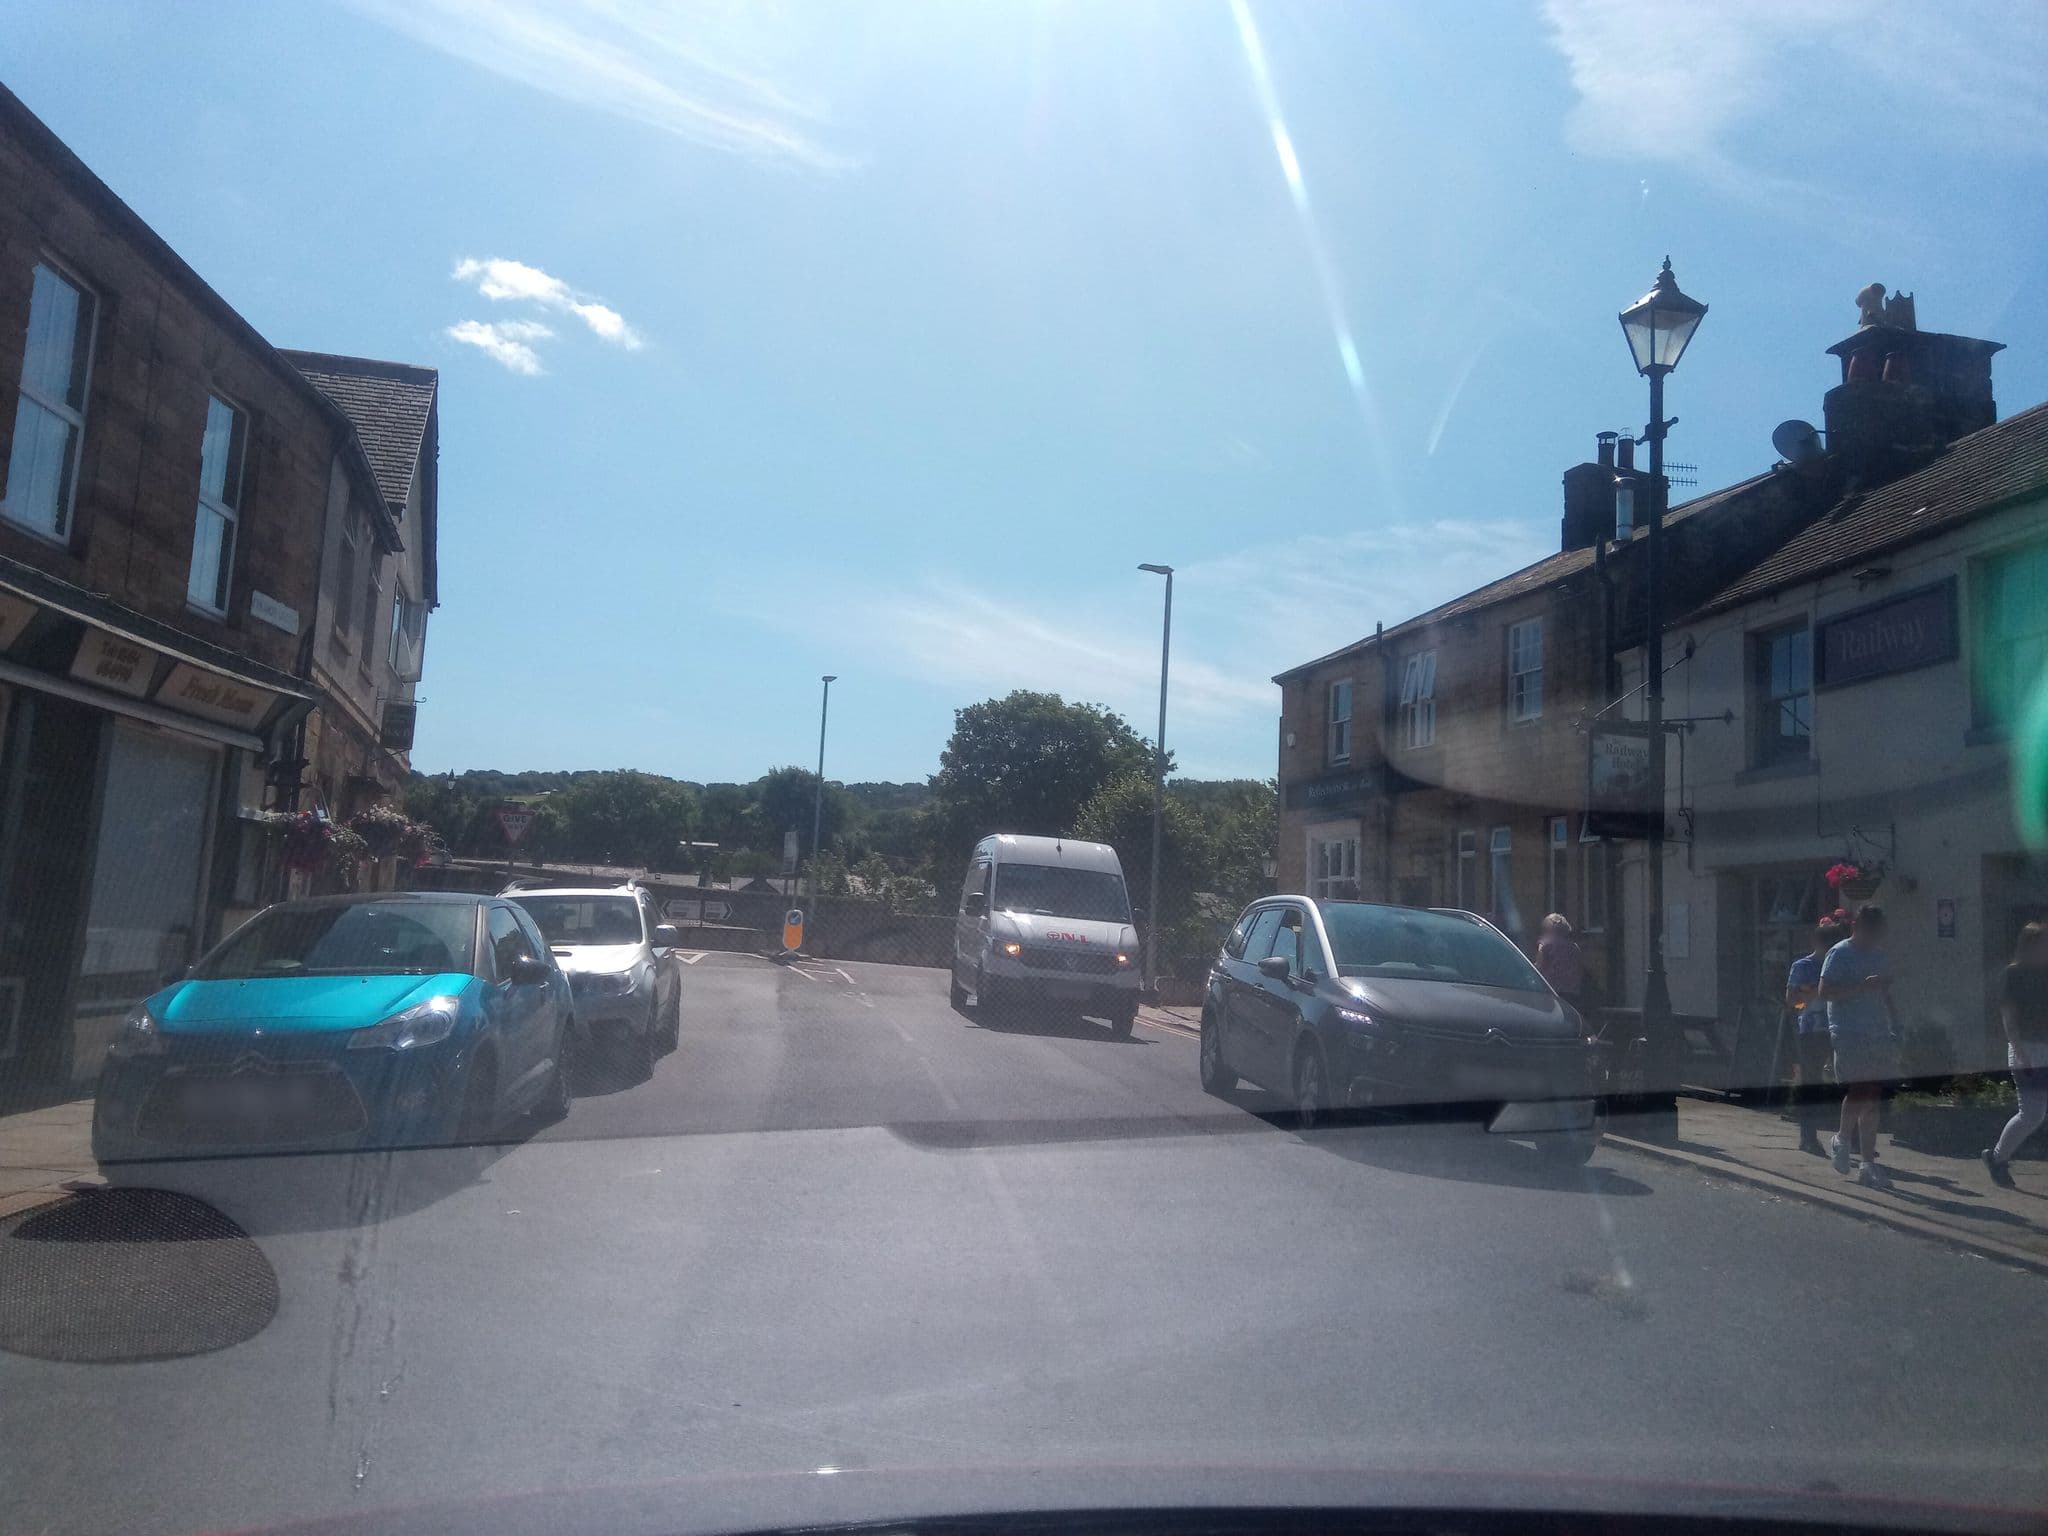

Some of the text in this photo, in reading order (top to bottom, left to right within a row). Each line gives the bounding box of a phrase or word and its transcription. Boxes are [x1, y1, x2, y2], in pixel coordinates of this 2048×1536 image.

[1839, 615, 1927, 662] Railway
[503, 814, 527, 824] GIVE
[506, 823, 528, 833] WAY
